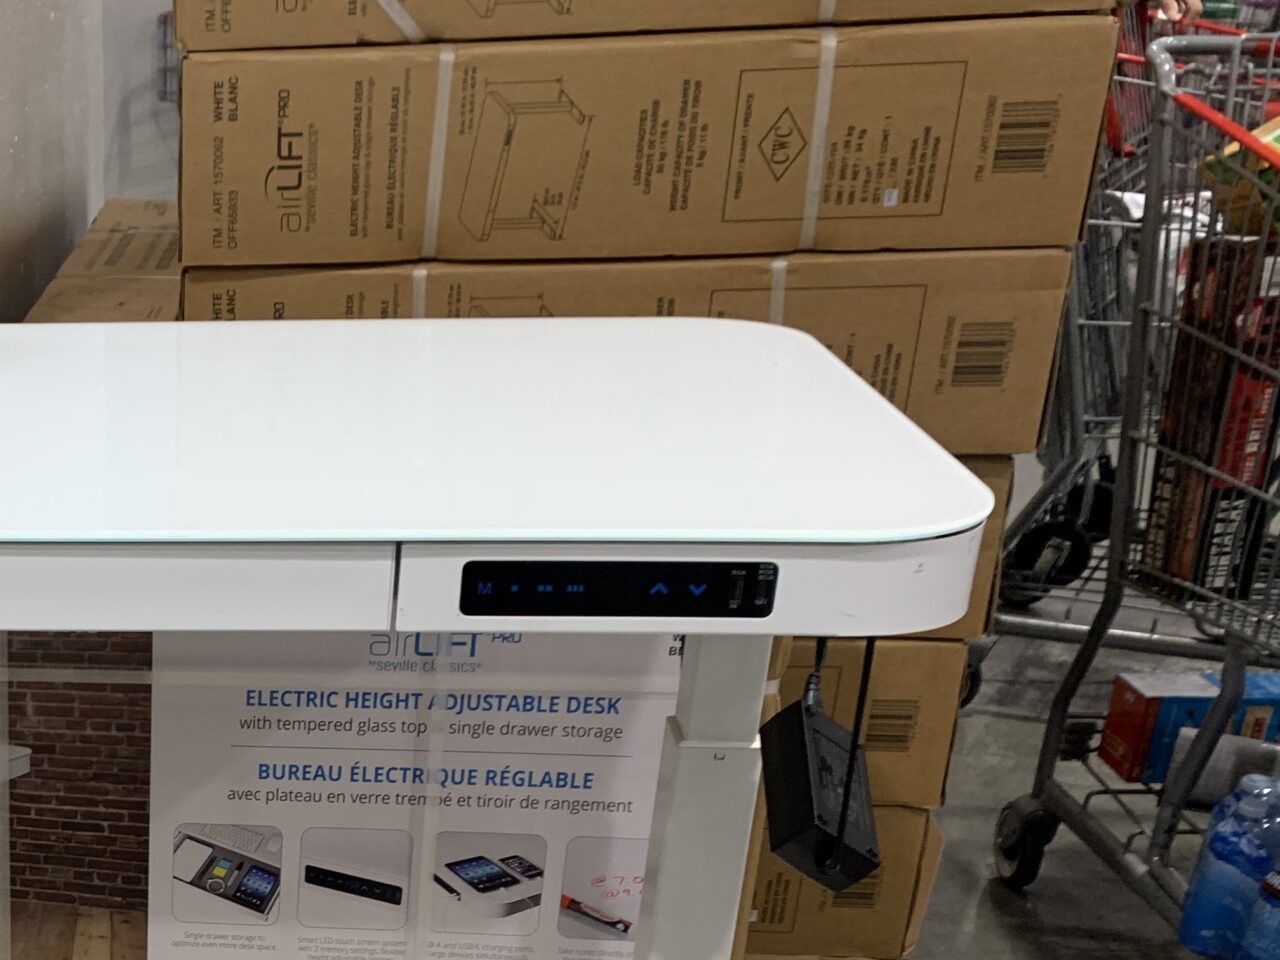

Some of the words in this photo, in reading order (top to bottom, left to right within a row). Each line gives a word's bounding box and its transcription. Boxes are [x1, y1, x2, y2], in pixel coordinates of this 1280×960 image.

[213, 81, 223, 122] WHITE
[228, 76, 238, 121] BLANC
[278, 89, 290, 118] PRO
[354, 80, 364, 103] DESK
[387, 87, 400, 132] RÉGLABLE
[352, 106, 363, 160] ADJUSTABLE
[770, 126, 793, 164] CWC
[213, 137, 223, 184] 1570062
[386, 136, 398, 190] ÉLECTRIQUE
[351, 163, 361, 195] HEIGHT
[350, 199, 359, 236] ELECTRIC
[386, 193, 395, 229] BUREAU
[212, 294, 222, 320] HITE
[227, 289, 236, 320] LANC
[273, 302, 285, 319] RO
[246, 689, 339, 709] ELECTRIC
[345, 691, 424, 711] HEIGHT
[566, 696, 622, 715] DESK
[239, 717, 272, 732] with
[276, 719, 353, 735] tempered
[357, 720, 398, 736] glass
[400, 721, 429, 737] top
[448, 722, 496, 740] single
[500, 722, 556, 738] drawer
[560, 724, 624, 742] storage
[257, 763, 342, 783] BUREAU
[485, 765, 594, 789] RÉGLABLE
[227, 788, 262, 802] avec
[265, 787, 323, 804] plateau
[327, 791, 346, 803] en
[350, 791, 391, 804] verre
[456, 793, 473, 806] et
[476, 793, 516, 808] tiroir
[520, 795, 540, 809] de
[544, 796, 634, 814] rangement
